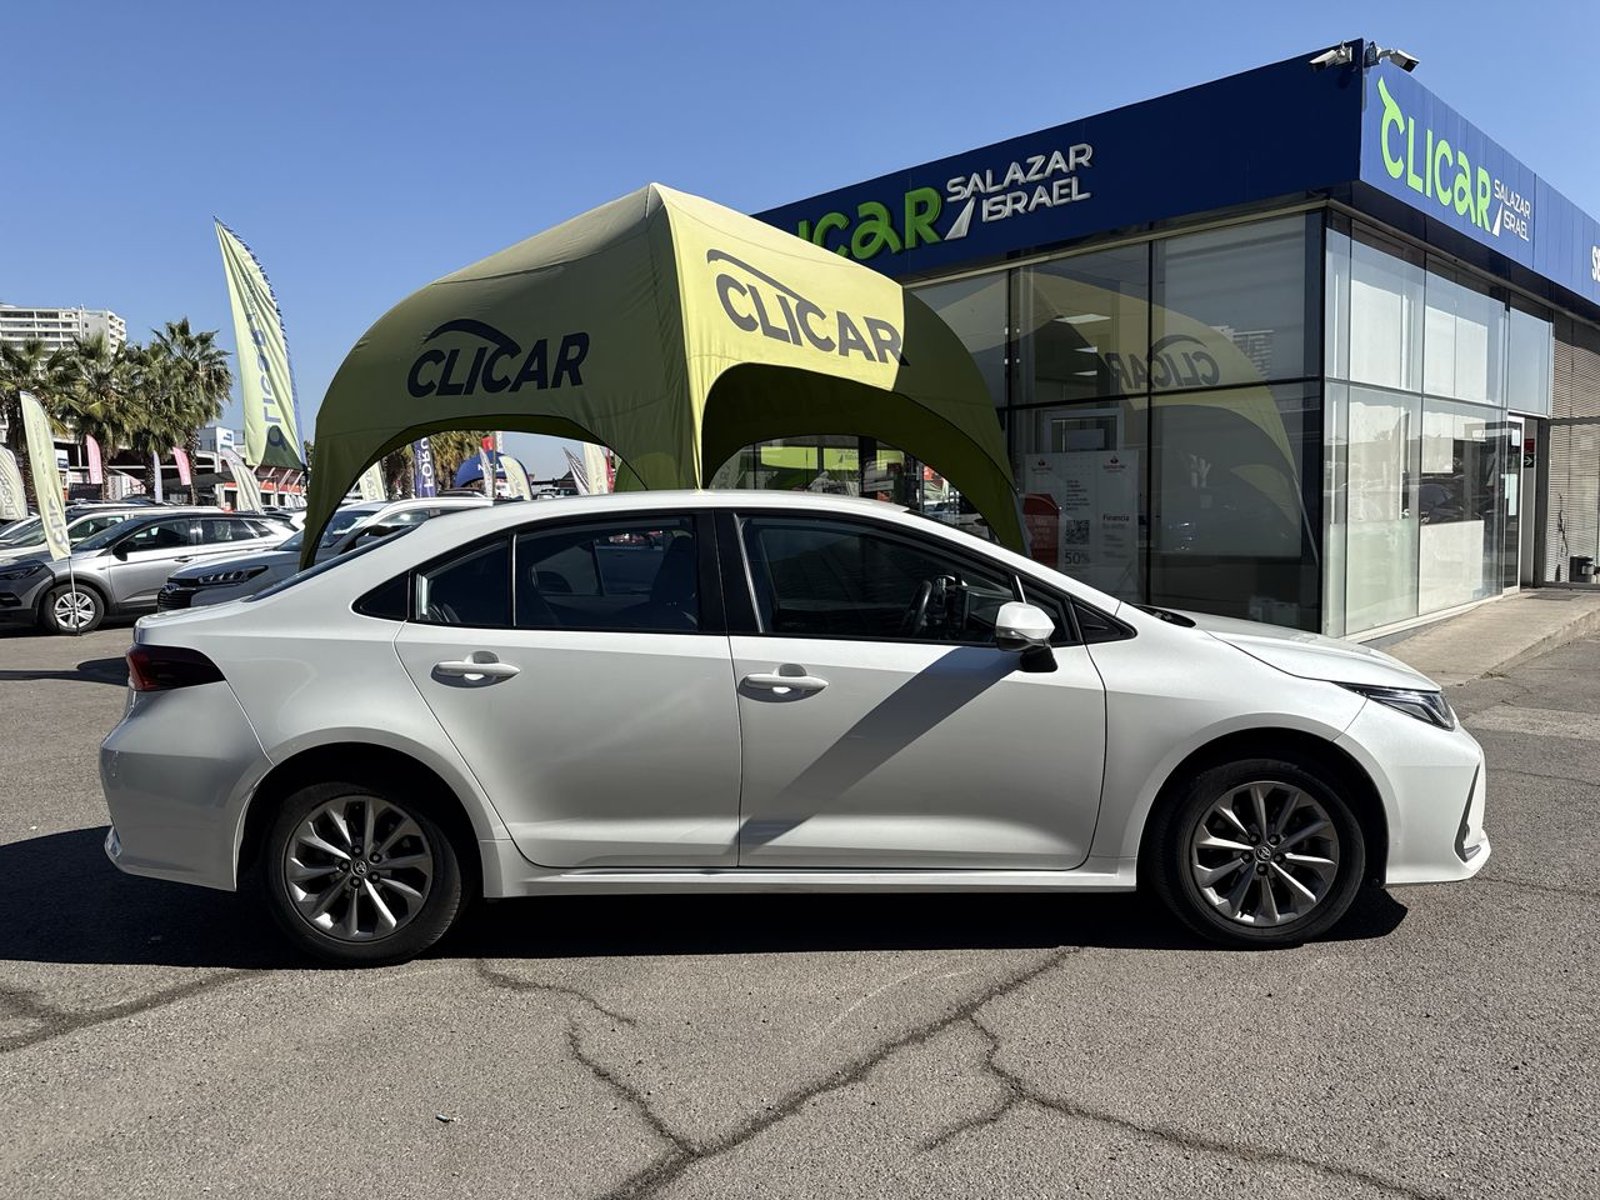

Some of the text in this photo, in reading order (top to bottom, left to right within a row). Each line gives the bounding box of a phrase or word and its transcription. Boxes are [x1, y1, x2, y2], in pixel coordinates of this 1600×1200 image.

[946, 143, 1094, 203] SALAZAR
[982, 176, 1093, 223] ISRAEL
[1494, 179, 1532, 219] SALAZAR
[1503, 213, 1530, 241] ISRAEL
[715, 273, 911, 367] CLICAR
[407, 332, 591, 398] CLICAR
